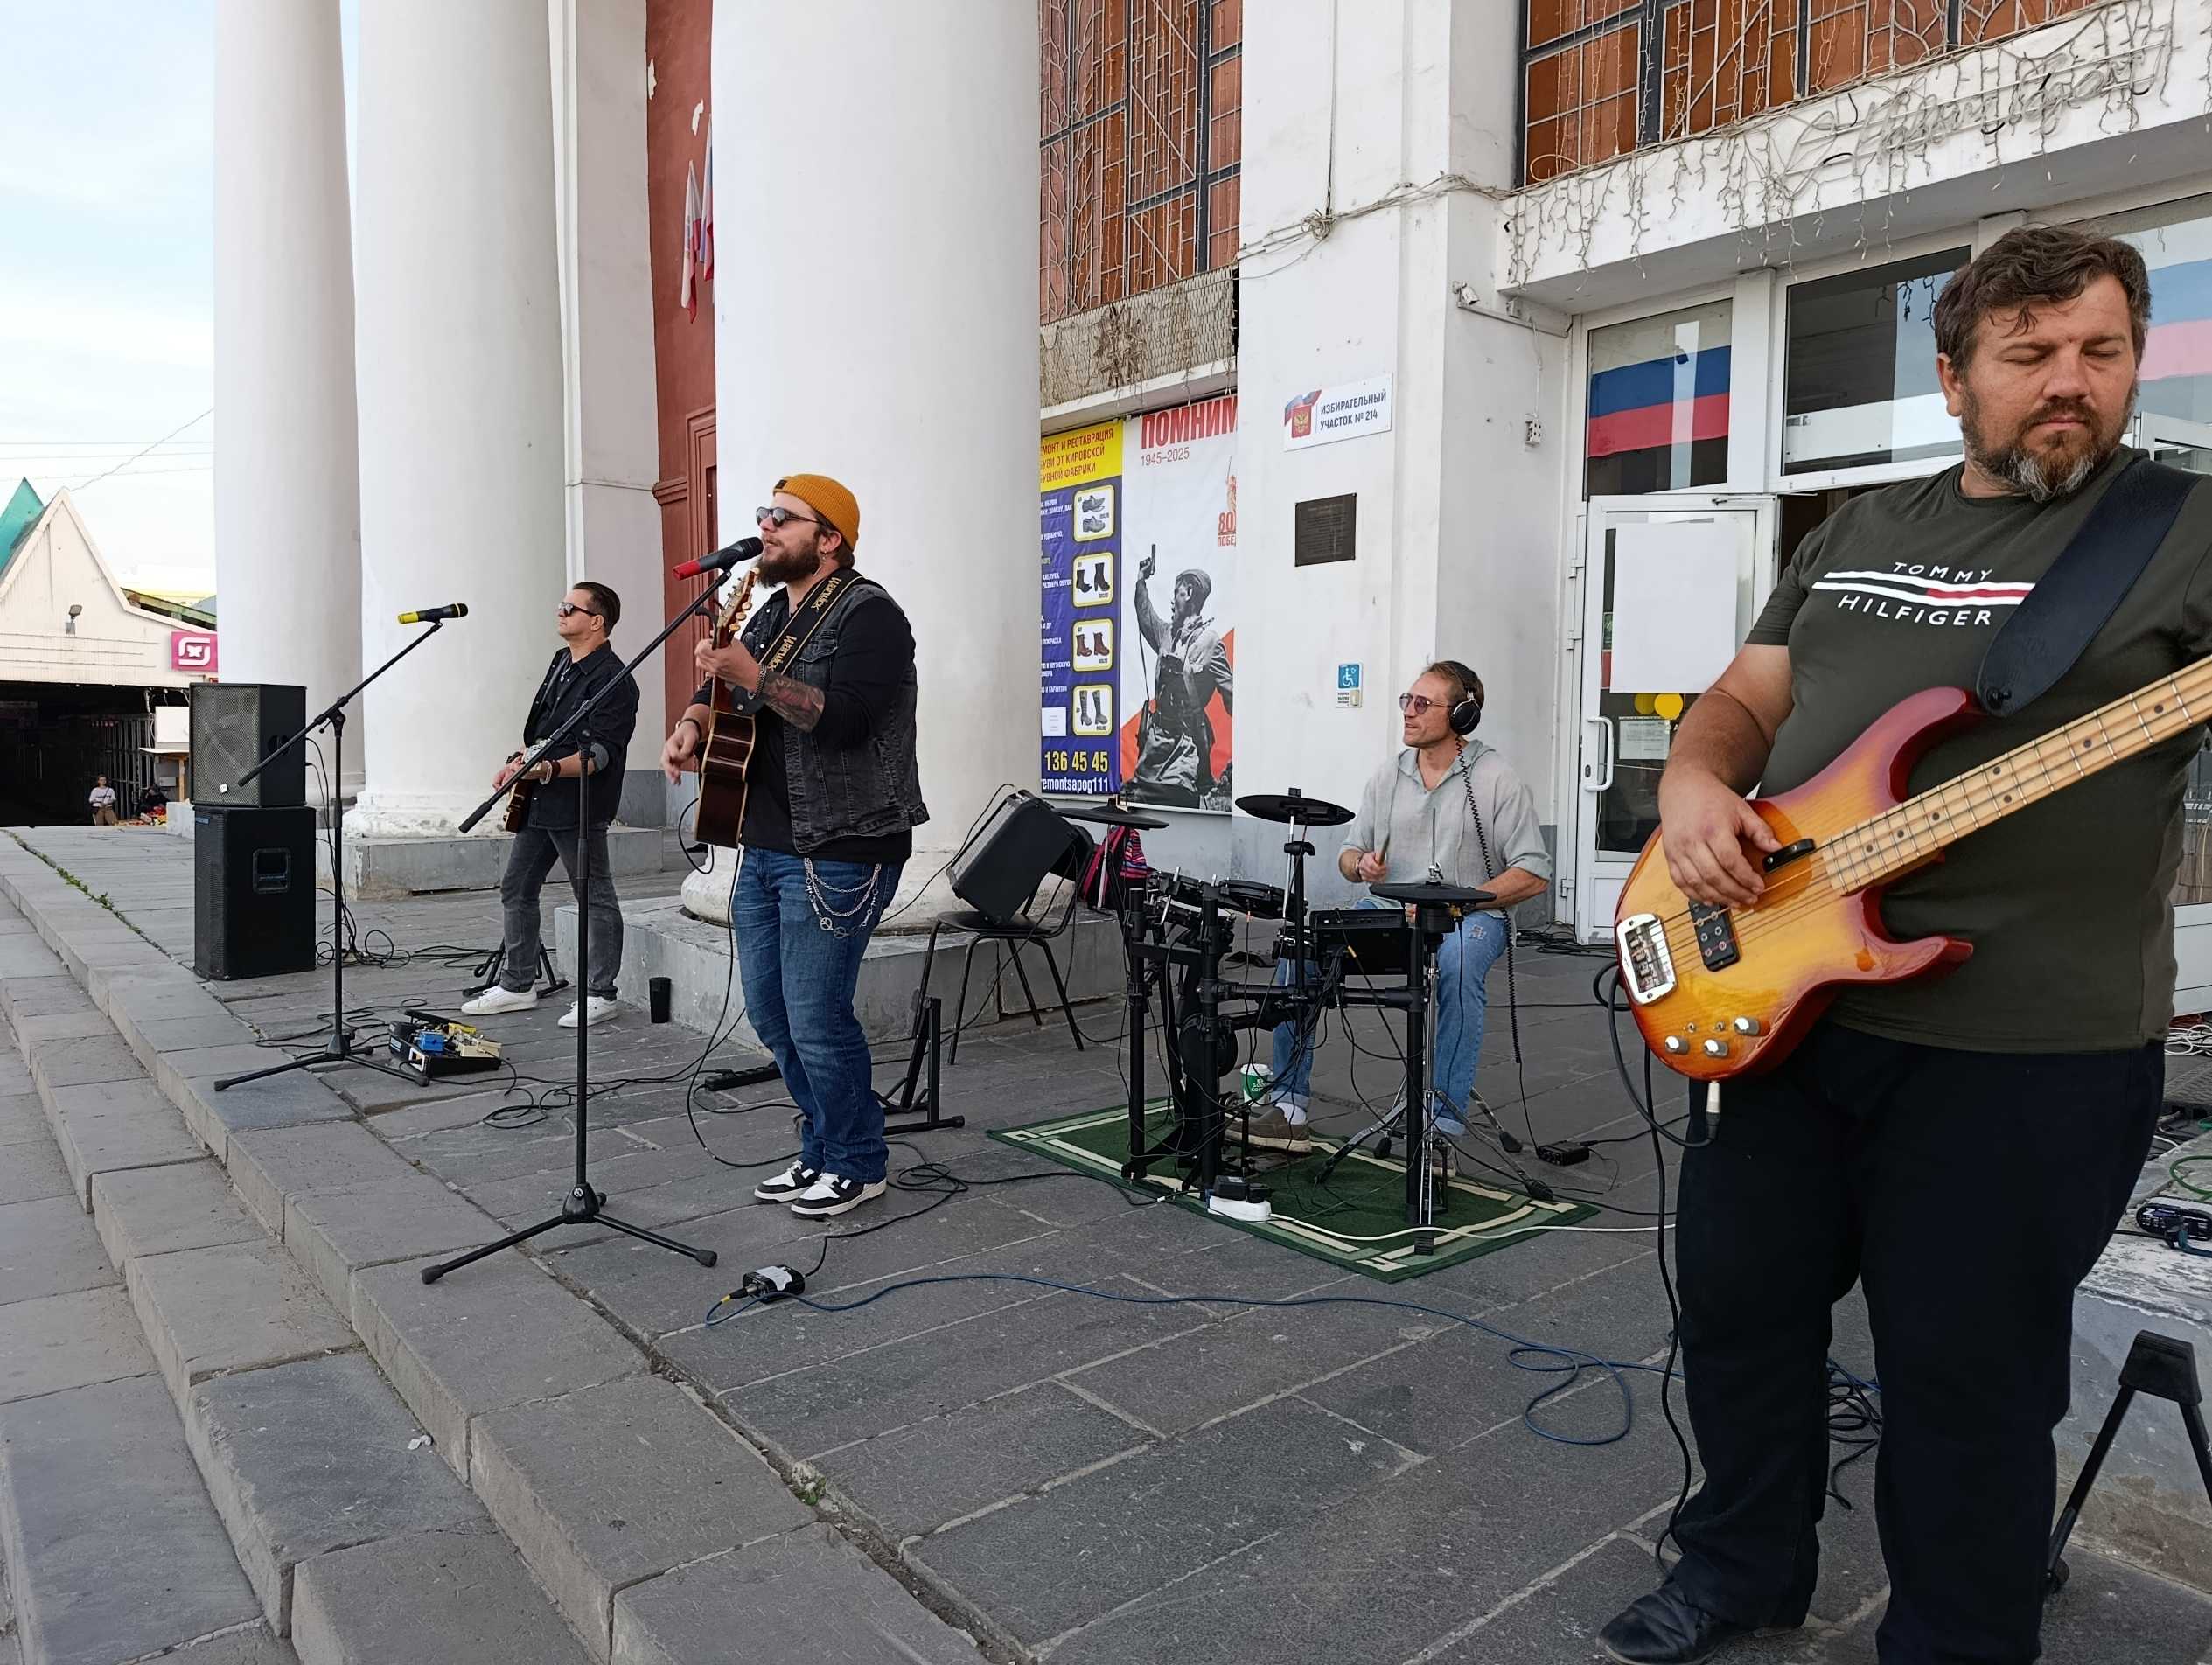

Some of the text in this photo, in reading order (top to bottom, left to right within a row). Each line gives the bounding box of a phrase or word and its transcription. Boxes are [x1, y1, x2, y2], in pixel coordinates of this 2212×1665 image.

[1321, 388, 1386, 415] ИЗБИРАТЕЛЬНЫЙ
[1141, 395, 1238, 449] ПОМНИМ
[1320, 415, 1353, 431] УЧАСТОК
[1365, 409, 1378, 421] 214
[1041, 428, 1113, 456] МОНТ И РЕСТАВРАЦИЯ
[1041, 443, 1105, 470] УВИ ОТ КИРОВСКОЙ
[1041, 462, 1096, 484] УВНОЙ ФАБРИКИ
[1218, 512, 1234, 532] 80
[1892, 561, 1993, 582] TOMMY
[1837, 594, 1992, 626] HILFIGER
[1044, 751, 1108, 773] 136 45 45
